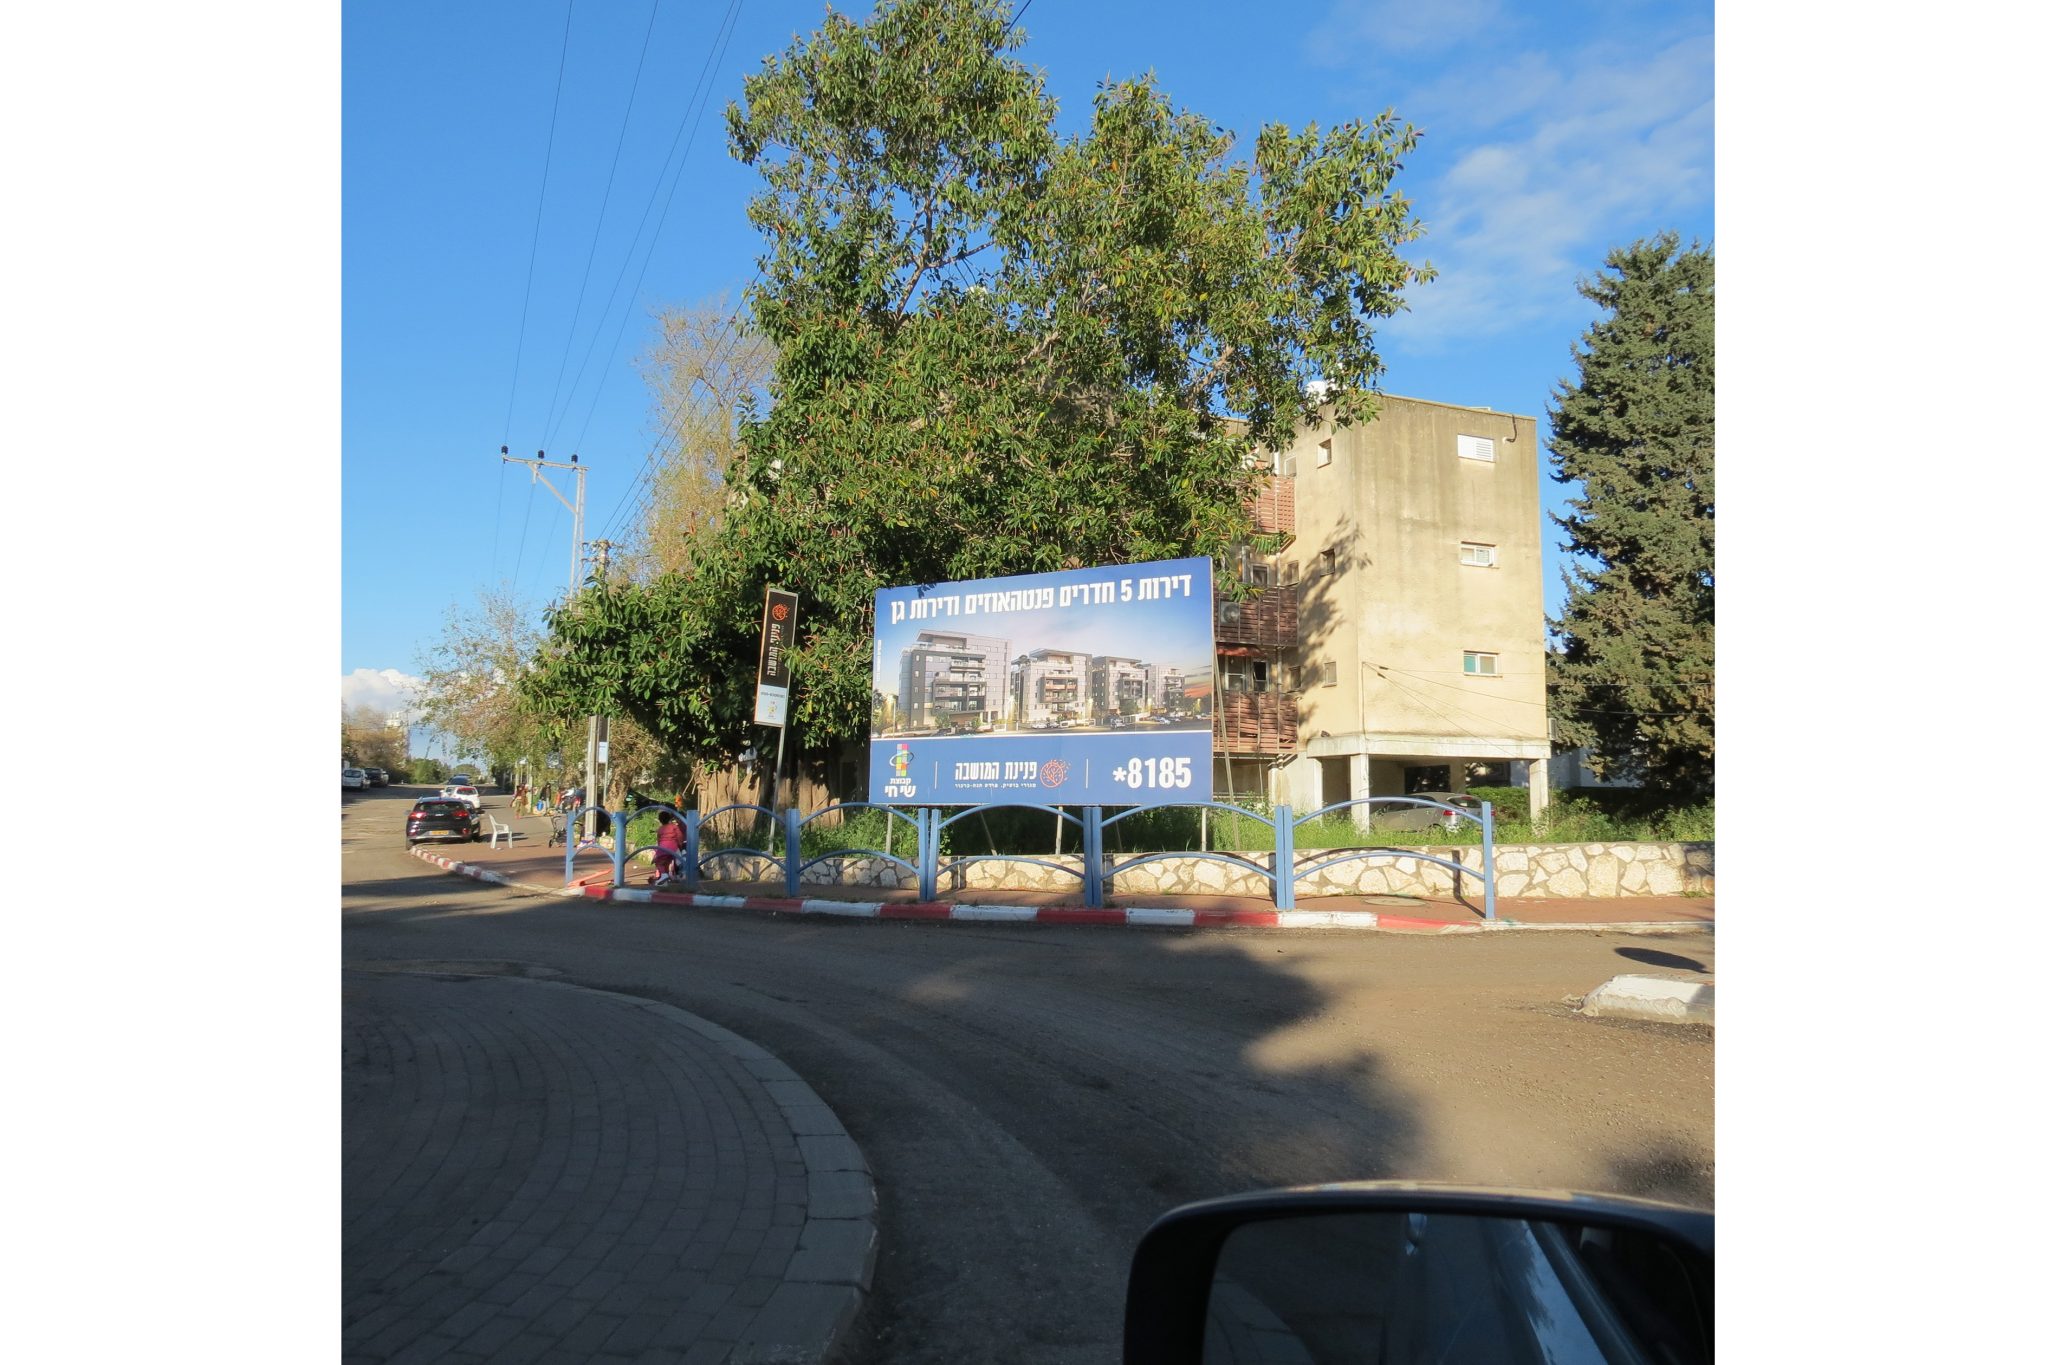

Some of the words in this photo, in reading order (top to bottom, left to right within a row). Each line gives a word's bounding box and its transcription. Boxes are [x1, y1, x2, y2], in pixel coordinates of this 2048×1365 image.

[1059, 581, 1116, 608] חדרים
[1120, 579, 1133, 602] 5
[1138, 574, 1192, 601] דירות
[891, 600, 905, 625] גן
[909, 595, 960, 620] ודירות
[965, 587, 1054, 615] פנטהאוזים
[955, 761, 1000, 781] המושבה
[1004, 761, 1038, 780] פנינת
[884, 785, 898, 798] חי
[899, 785, 917, 798] שי
